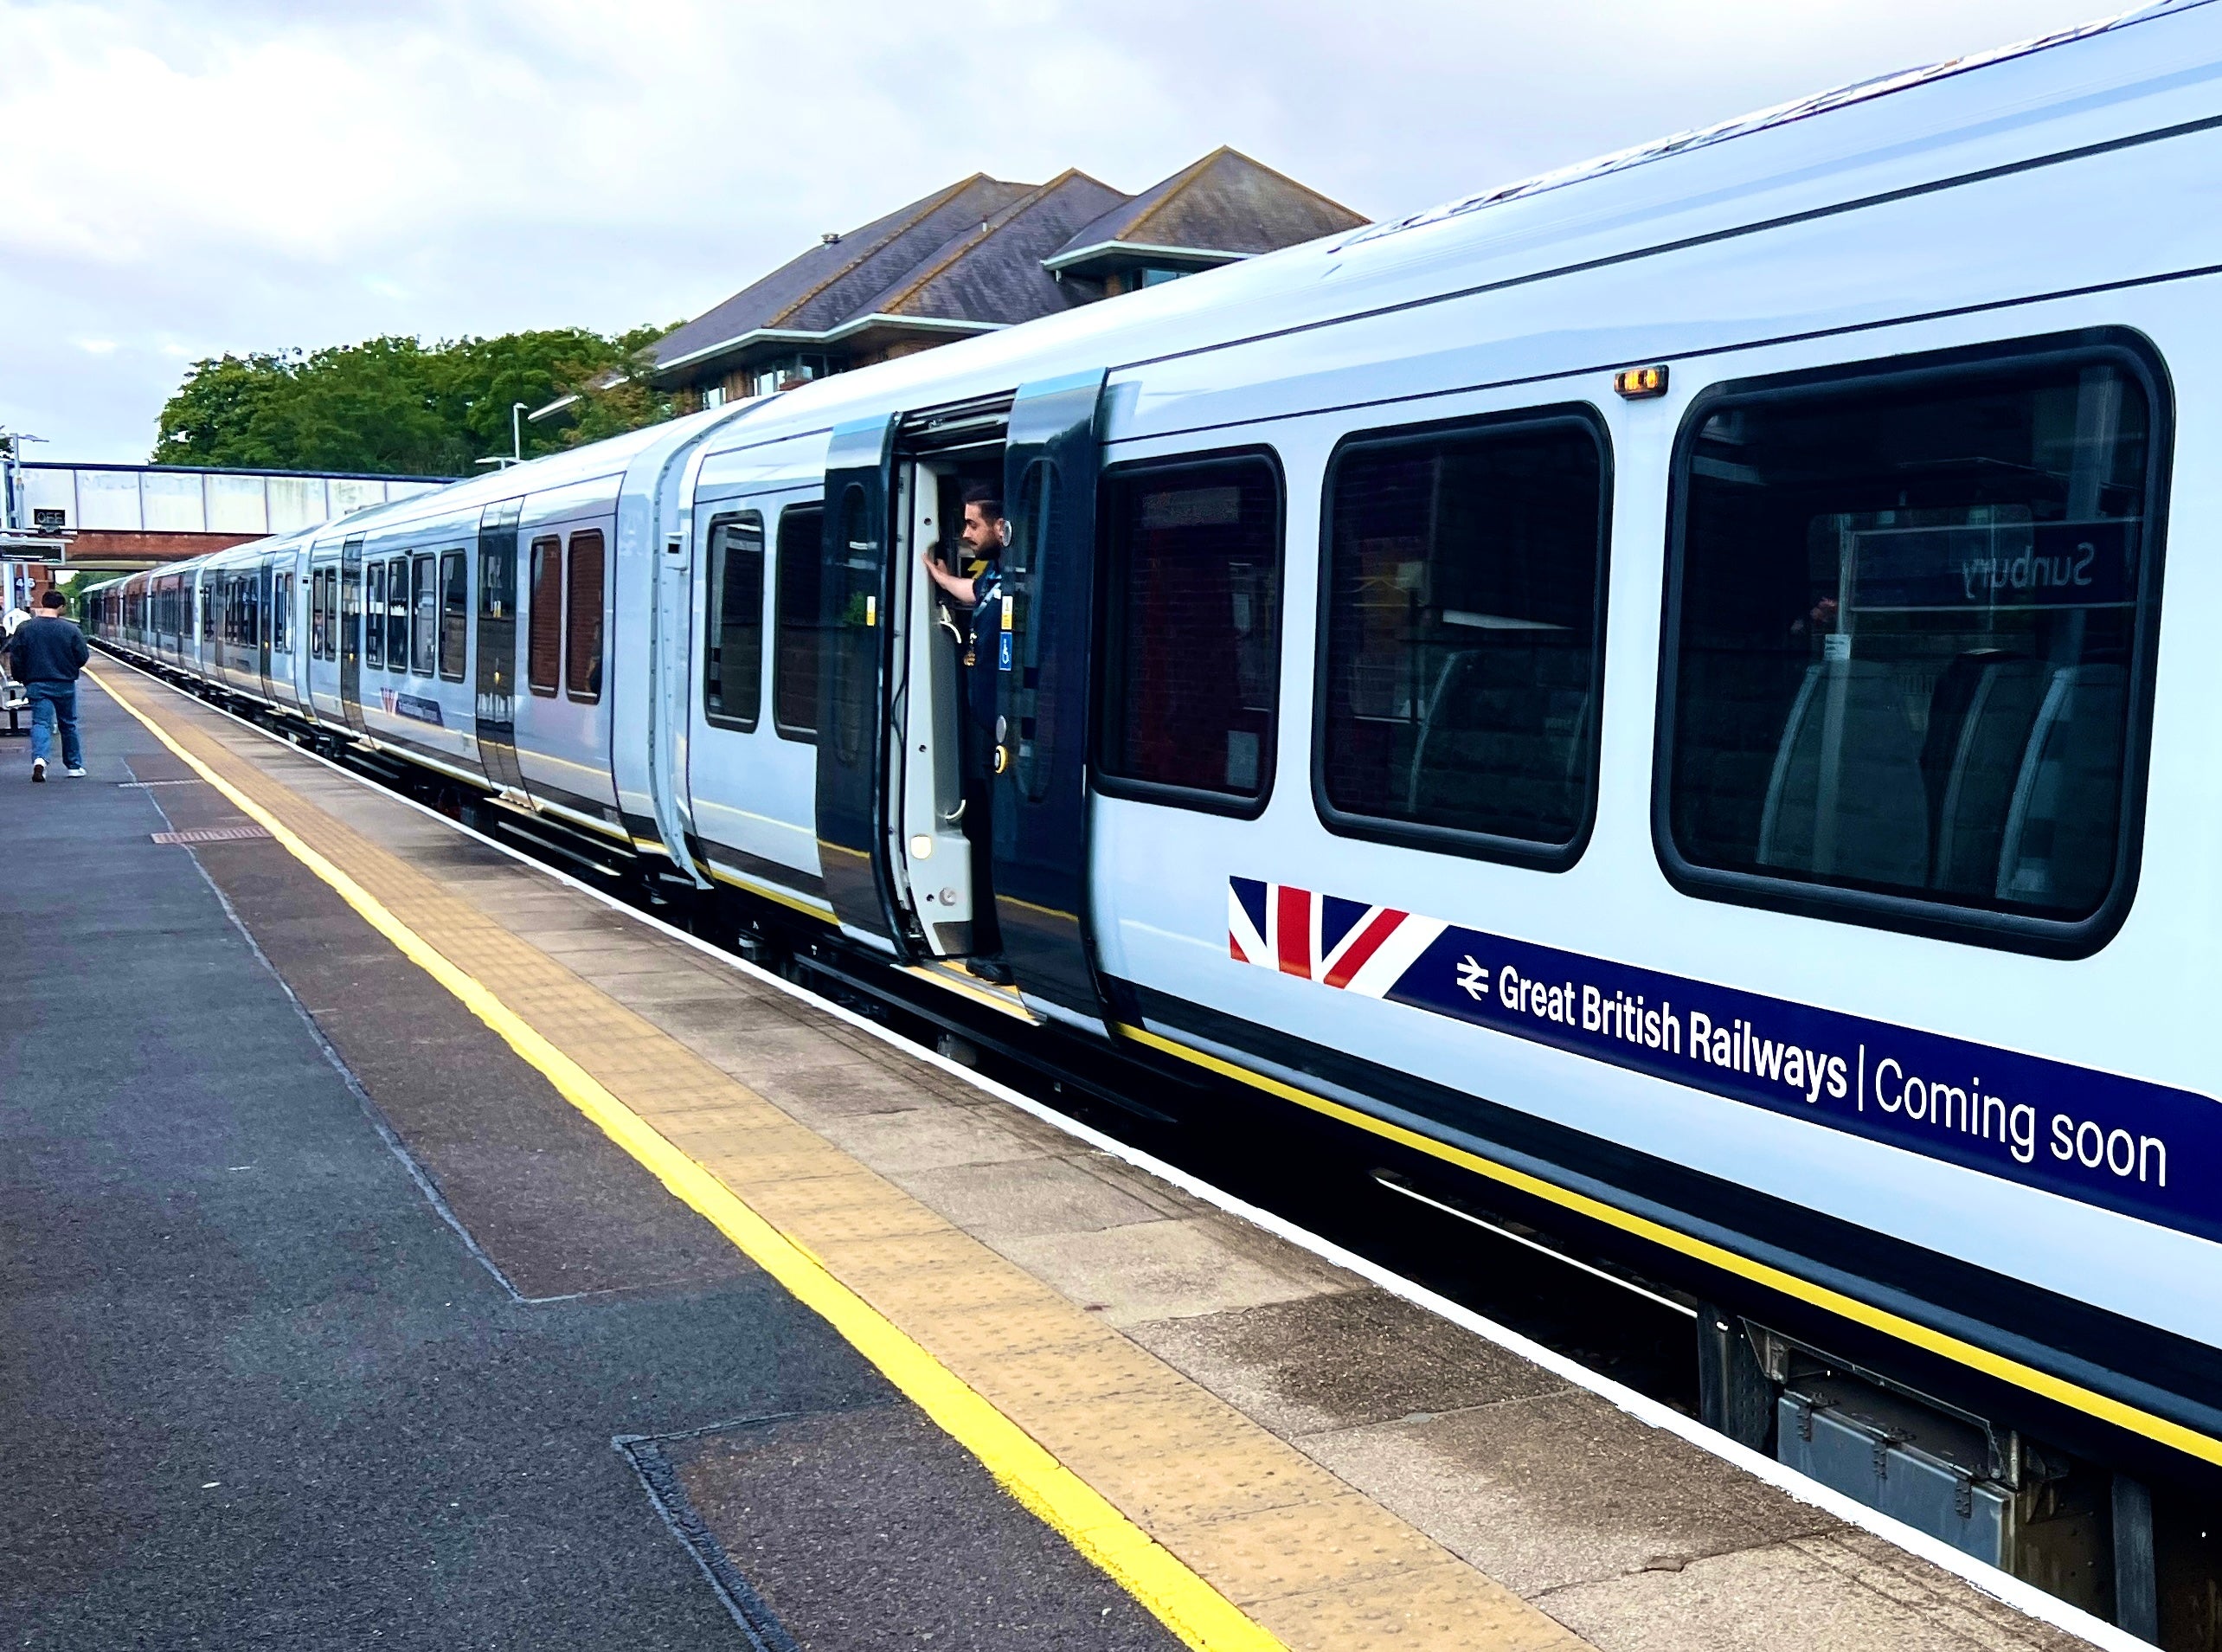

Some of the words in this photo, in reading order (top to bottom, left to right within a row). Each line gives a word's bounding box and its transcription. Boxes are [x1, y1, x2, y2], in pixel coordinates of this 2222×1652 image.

[1499, 965, 1576, 1026] Great
[1583, 984, 1680, 1064] British
[1690, 1011, 1847, 1103] Railways
[1875, 1057, 2035, 1163] Coming
[2050, 1114, 2167, 1187] soon
